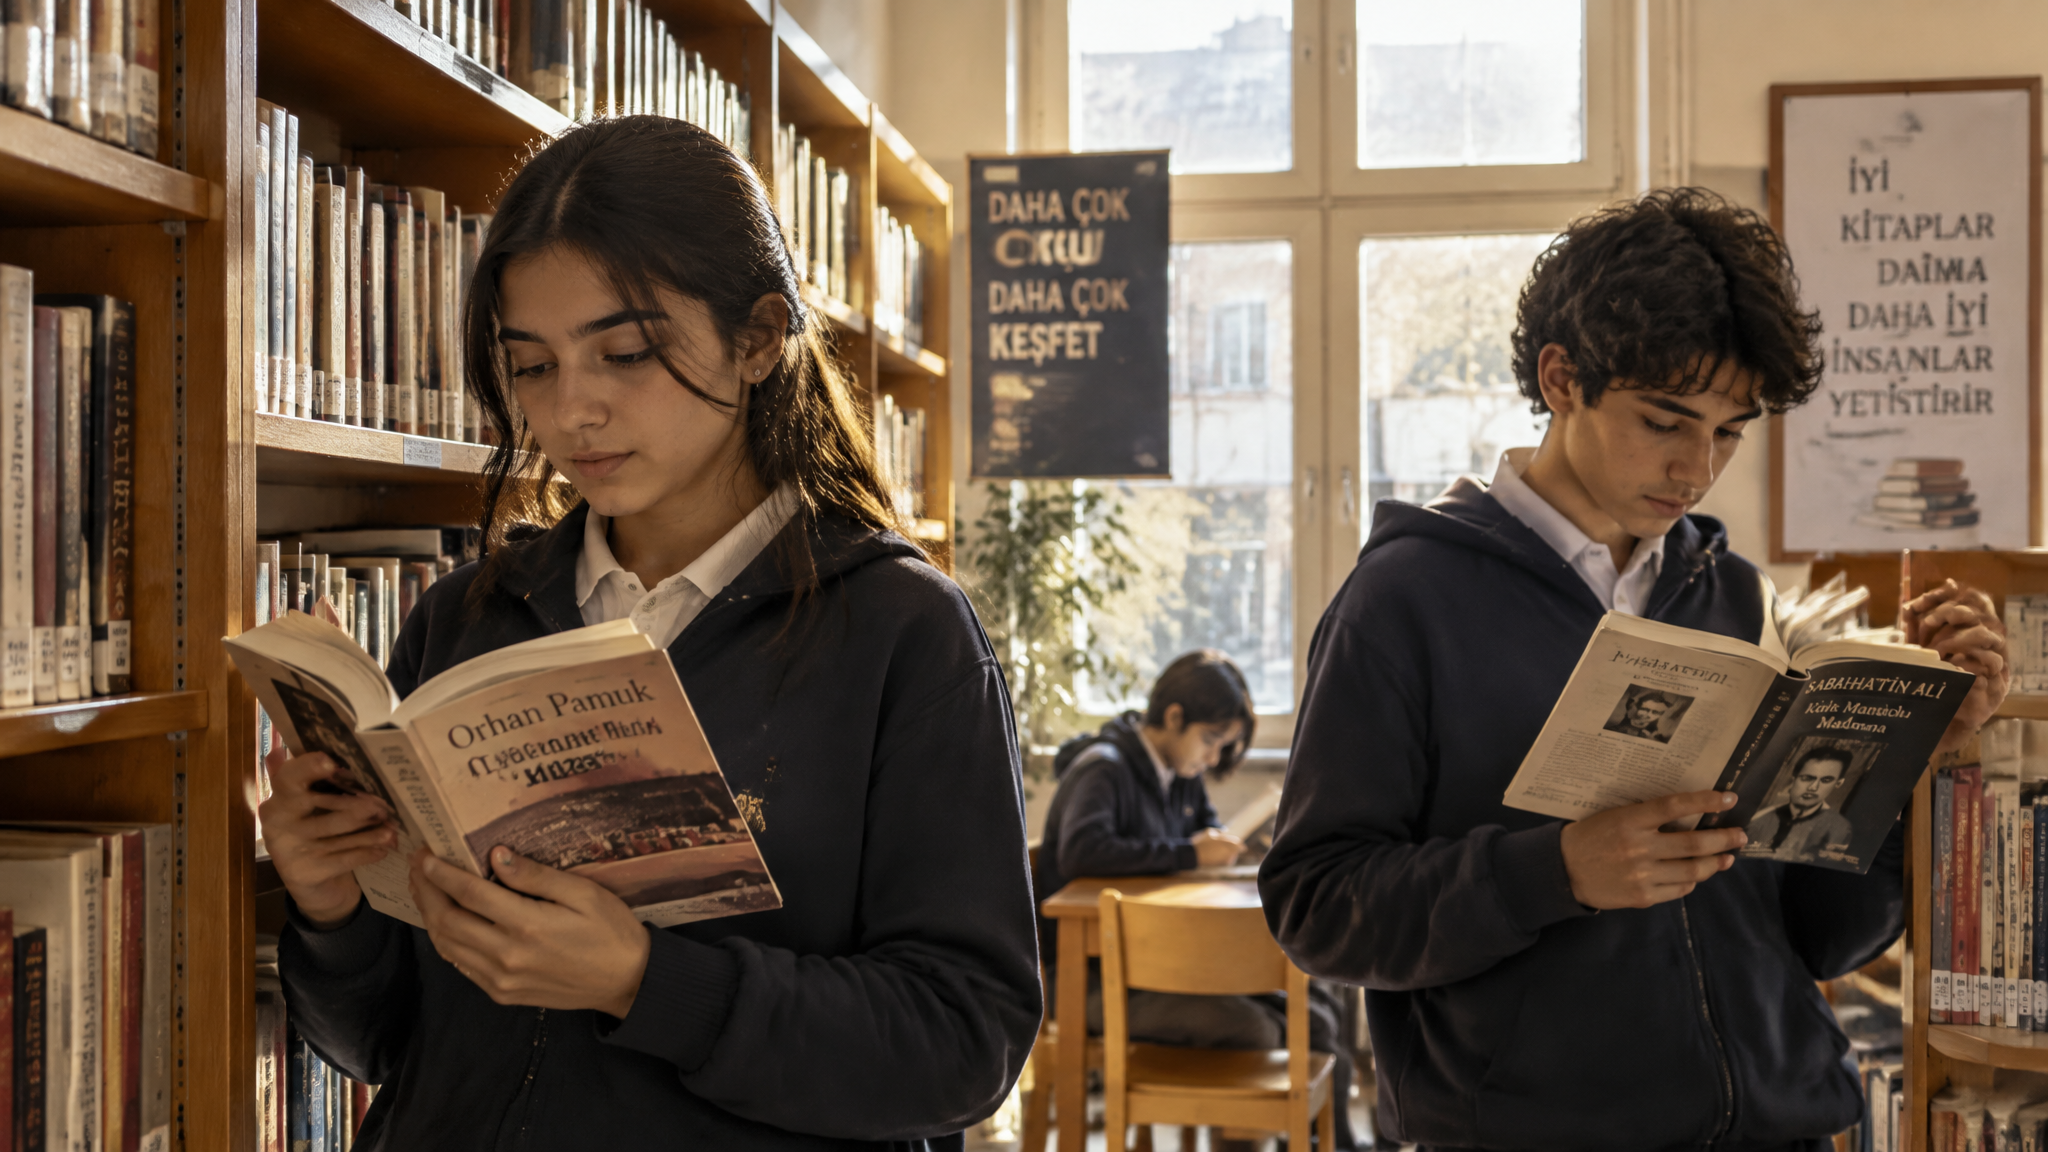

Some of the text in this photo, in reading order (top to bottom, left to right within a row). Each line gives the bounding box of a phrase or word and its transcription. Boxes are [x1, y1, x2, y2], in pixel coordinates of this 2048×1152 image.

[1849, 156, 1889, 194] İYİ
[988, 187, 1131, 228] DAHA ÇOK
[1840, 208, 1995, 243] KİTAPLAR
[988, 277, 1130, 319] DAHA ÇOK
[1849, 290, 1988, 331] DAHA İYİ
[988, 321, 1104, 367] KEŞFET
[1832, 337, 1994, 374] İNSANLAR
[1911, 681, 1947, 699] ALİ
[447, 705, 545, 749] Orhan
[546, 679, 656, 718] Pamuk
